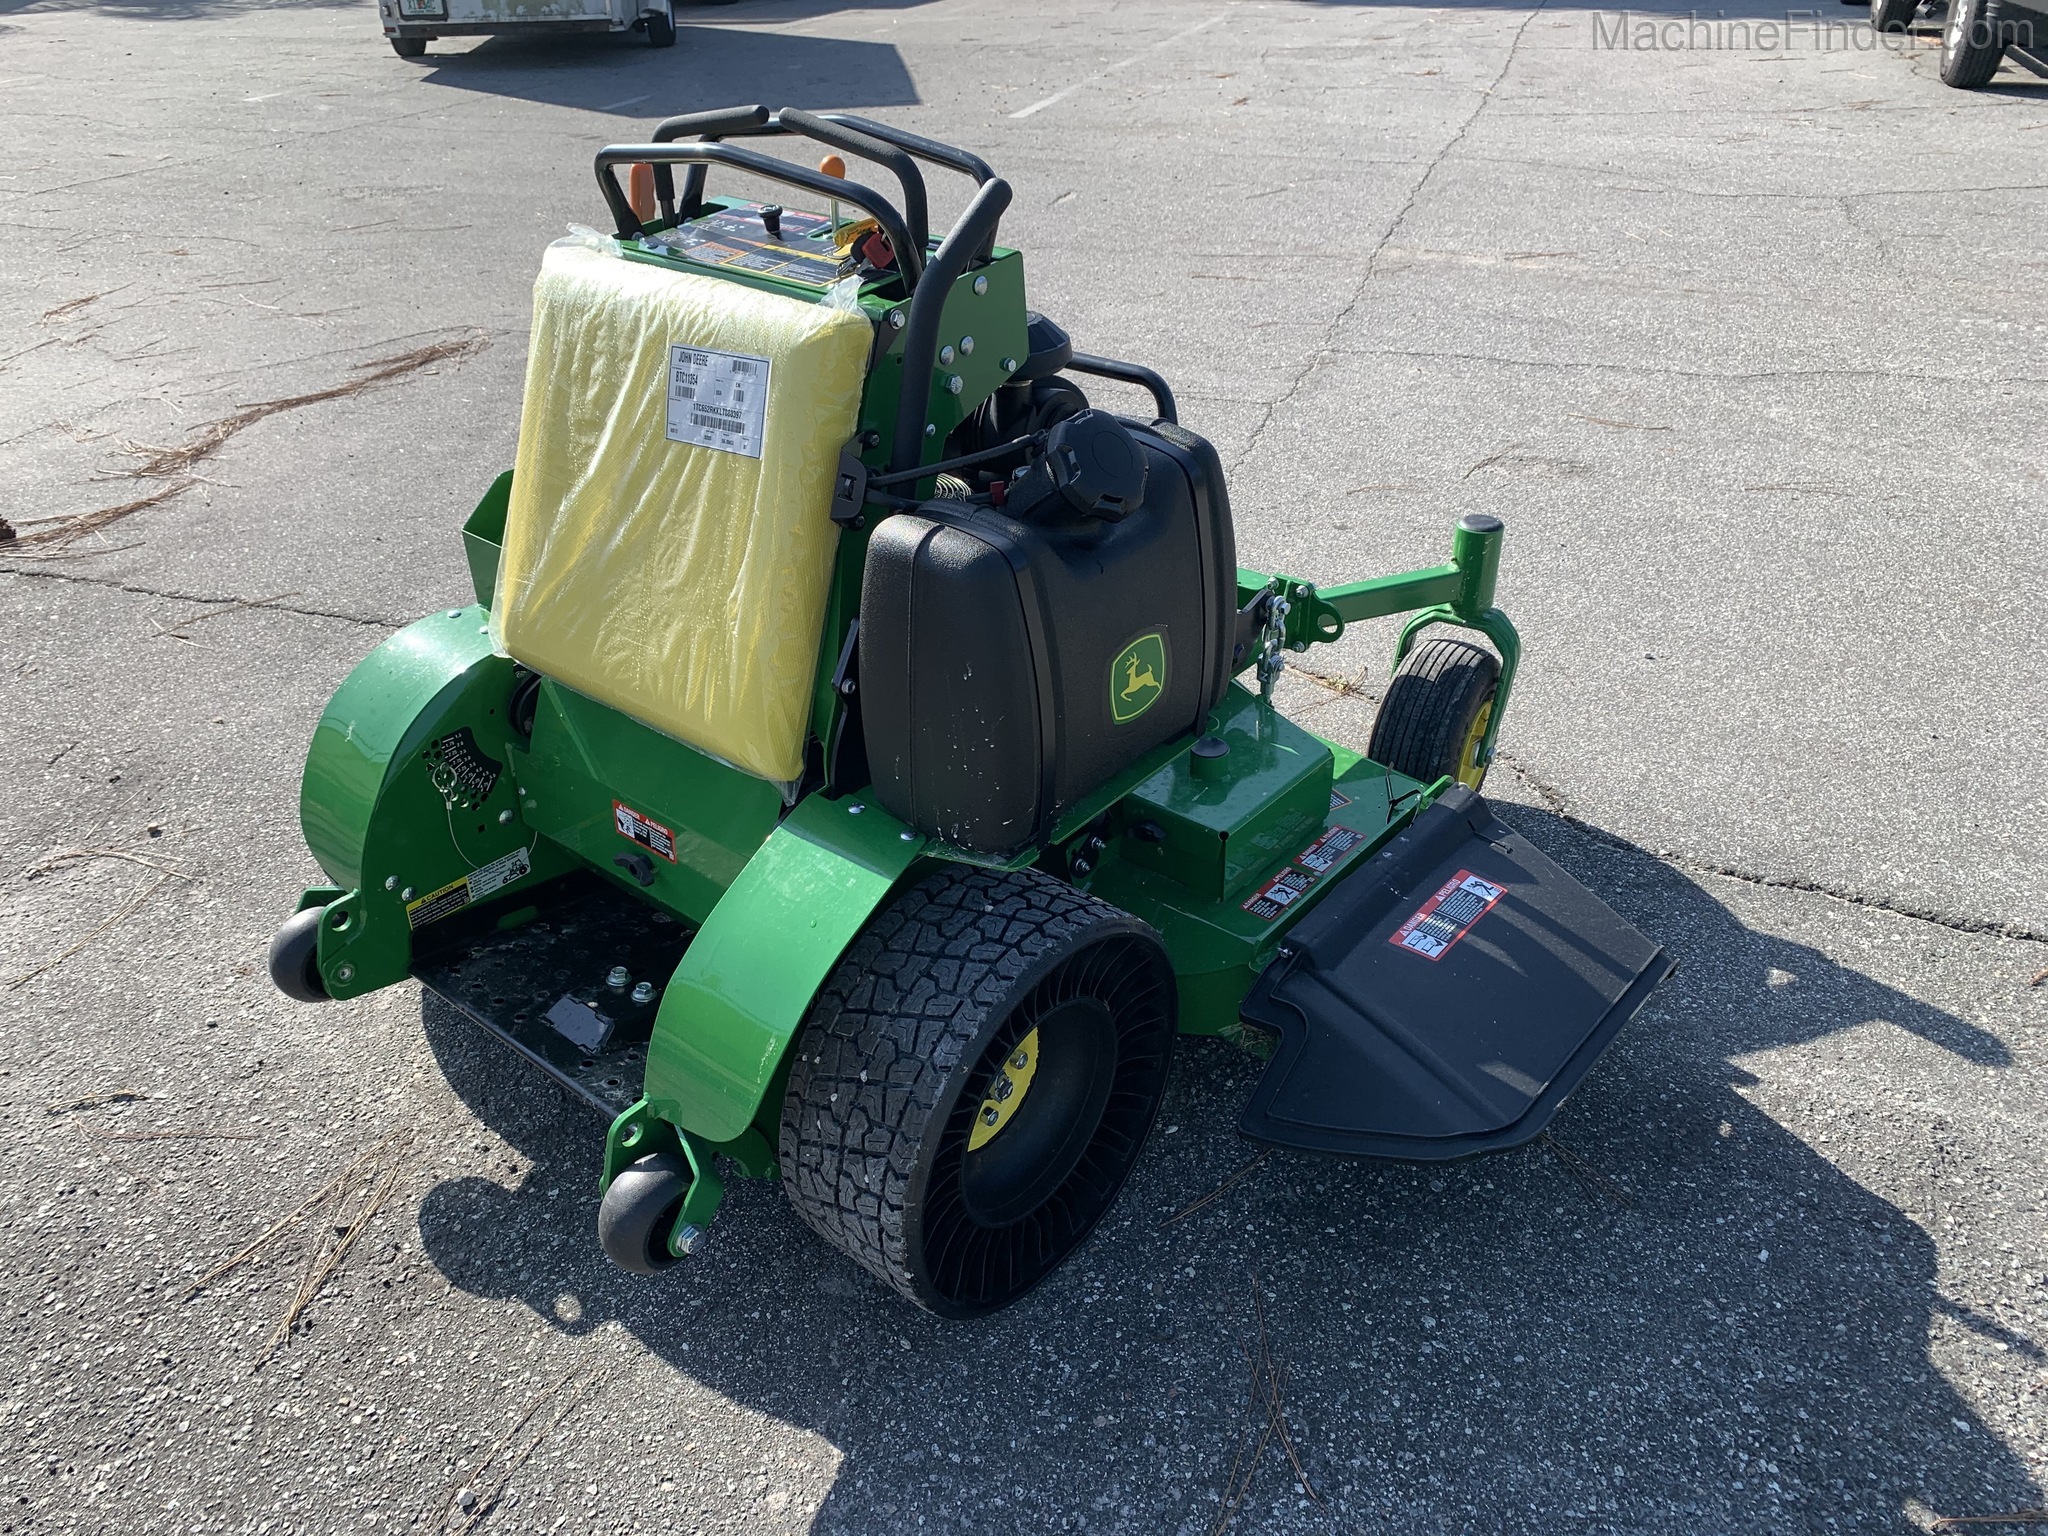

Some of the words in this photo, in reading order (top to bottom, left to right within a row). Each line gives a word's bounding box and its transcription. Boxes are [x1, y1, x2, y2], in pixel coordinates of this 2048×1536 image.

[678, 352, 692, 365] JOHN
[693, 353, 709, 366] DEERE
[624, 806, 640, 820] DANGER
[650, 821, 668, 835] PELIGRO
[426, 884, 454, 900] CAUTION
[1404, 912, 1428, 931] DANGER
[1438, 878, 1461, 898] PELIGRO
